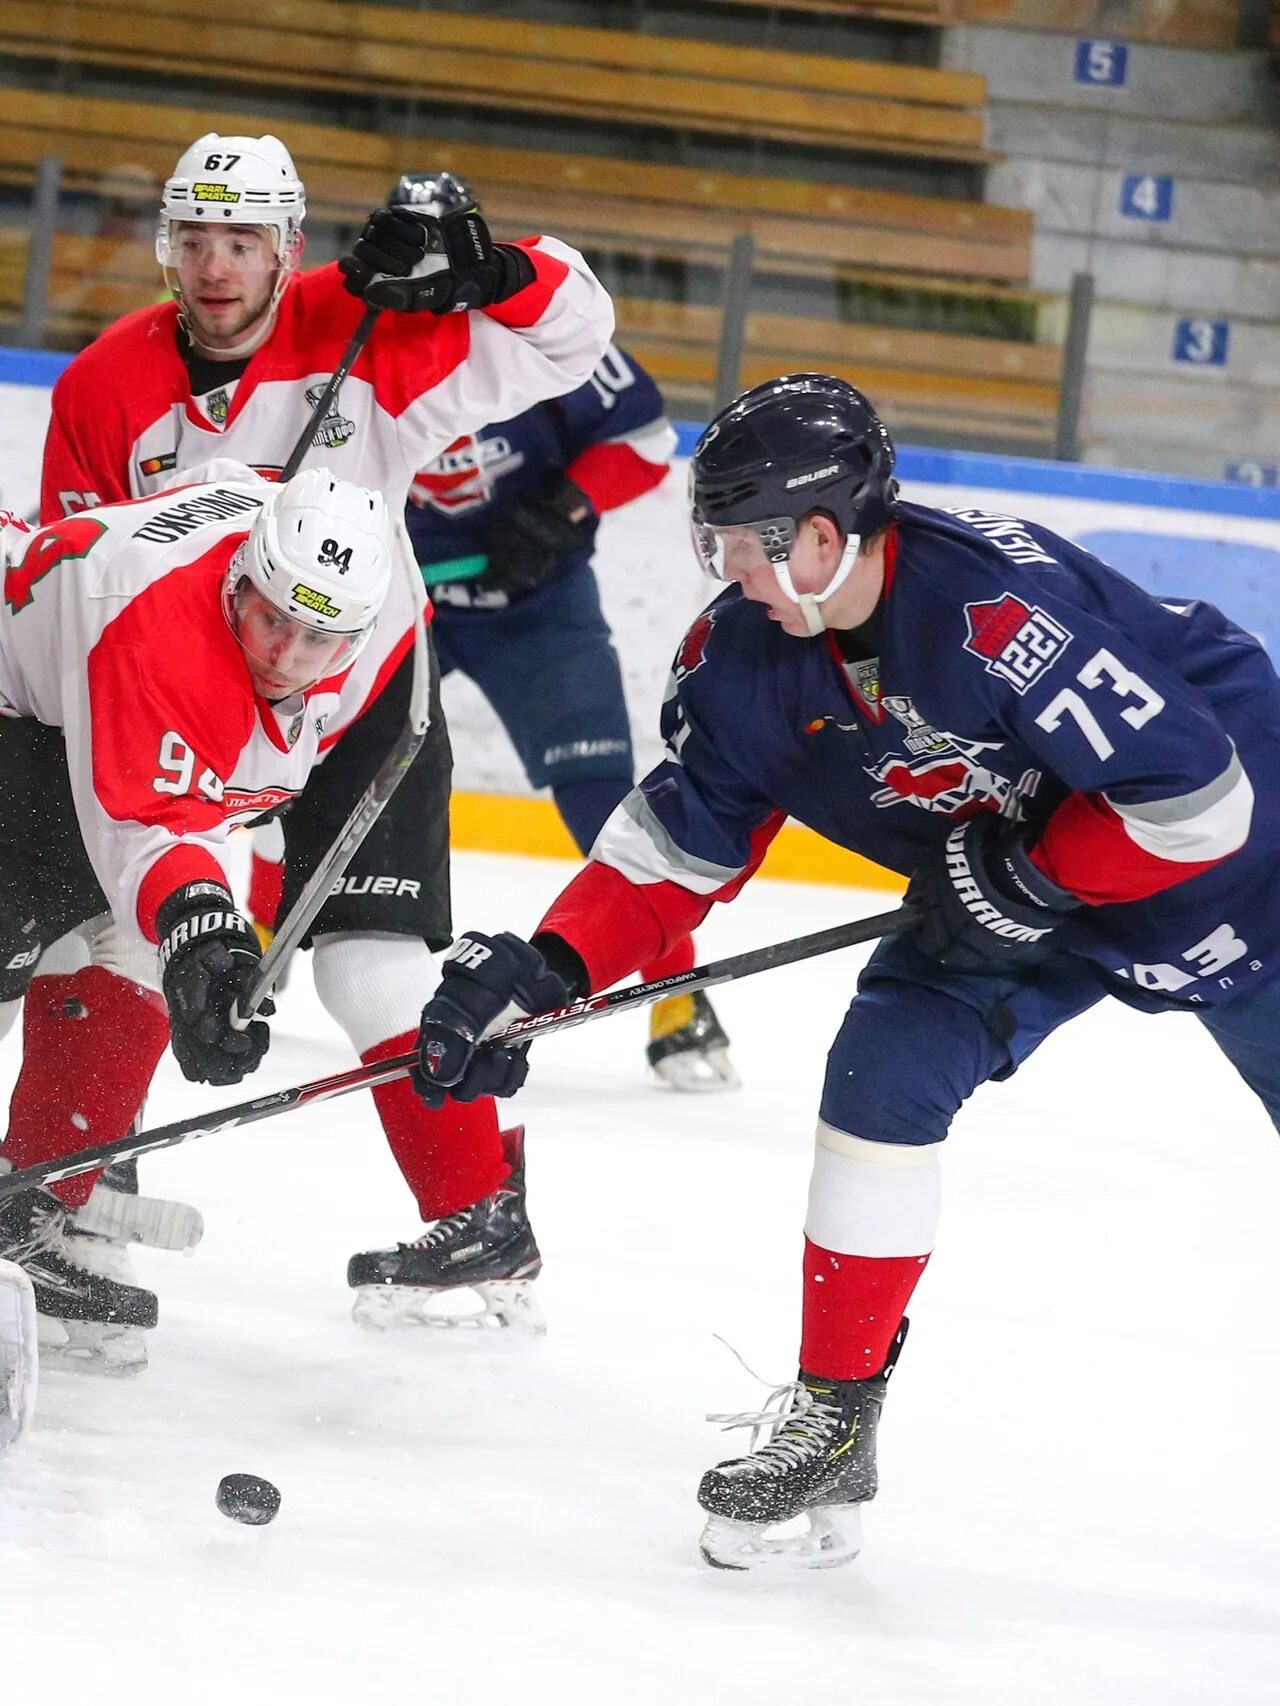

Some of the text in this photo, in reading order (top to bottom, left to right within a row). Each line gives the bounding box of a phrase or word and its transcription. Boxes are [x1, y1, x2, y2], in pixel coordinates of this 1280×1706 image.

[1090, 41, 1112, 78] 5
[204, 154, 241, 171] 67
[195, 184, 225, 193] PARI
[197, 192, 239, 202] MATCH
[1132, 176, 1158, 215] 4
[1186, 320, 1215, 362] 3
[785, 464, 840, 489] BAUER
[317, 538, 354, 575] 94
[295, 585, 330, 605] PARI
[296, 594, 340, 617] MATCH
[992, 612, 1067, 689] 1221
[1034, 647, 1166, 762] 73
